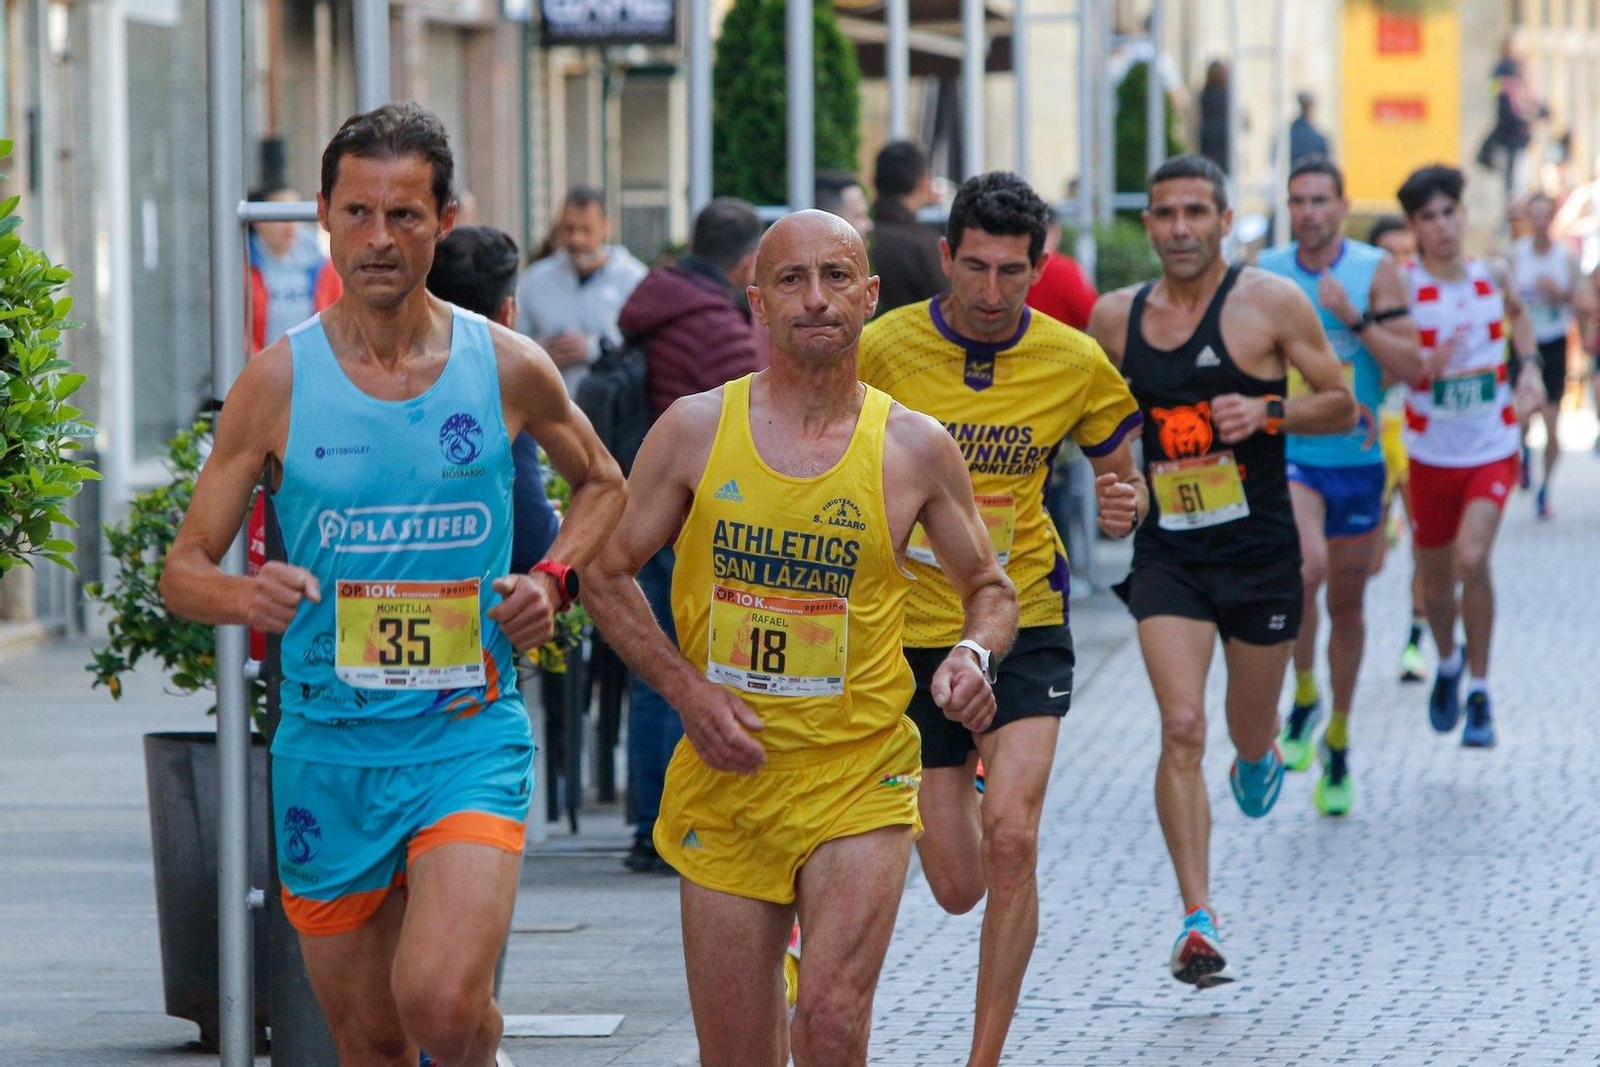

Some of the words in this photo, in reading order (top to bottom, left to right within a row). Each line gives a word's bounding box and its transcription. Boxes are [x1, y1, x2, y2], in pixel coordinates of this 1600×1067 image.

[939, 421, 1034, 445] ANINOS
[821, 498, 862, 518] FISIOTERAPIA
[1178, 482, 1206, 513] 61
[350, 514, 479, 542] PLASTIFER
[813, 515, 824, 525] S.
[713, 519, 861, 568] ATHLETICS
[714, 552, 756, 583] SAN
[763, 560, 850, 597] LÁZARO
[376, 603, 432, 614] MONTILLA
[751, 613, 789, 628] RAFAEL
[379, 618, 431, 666] 35
[750, 627, 787, 674] 18
